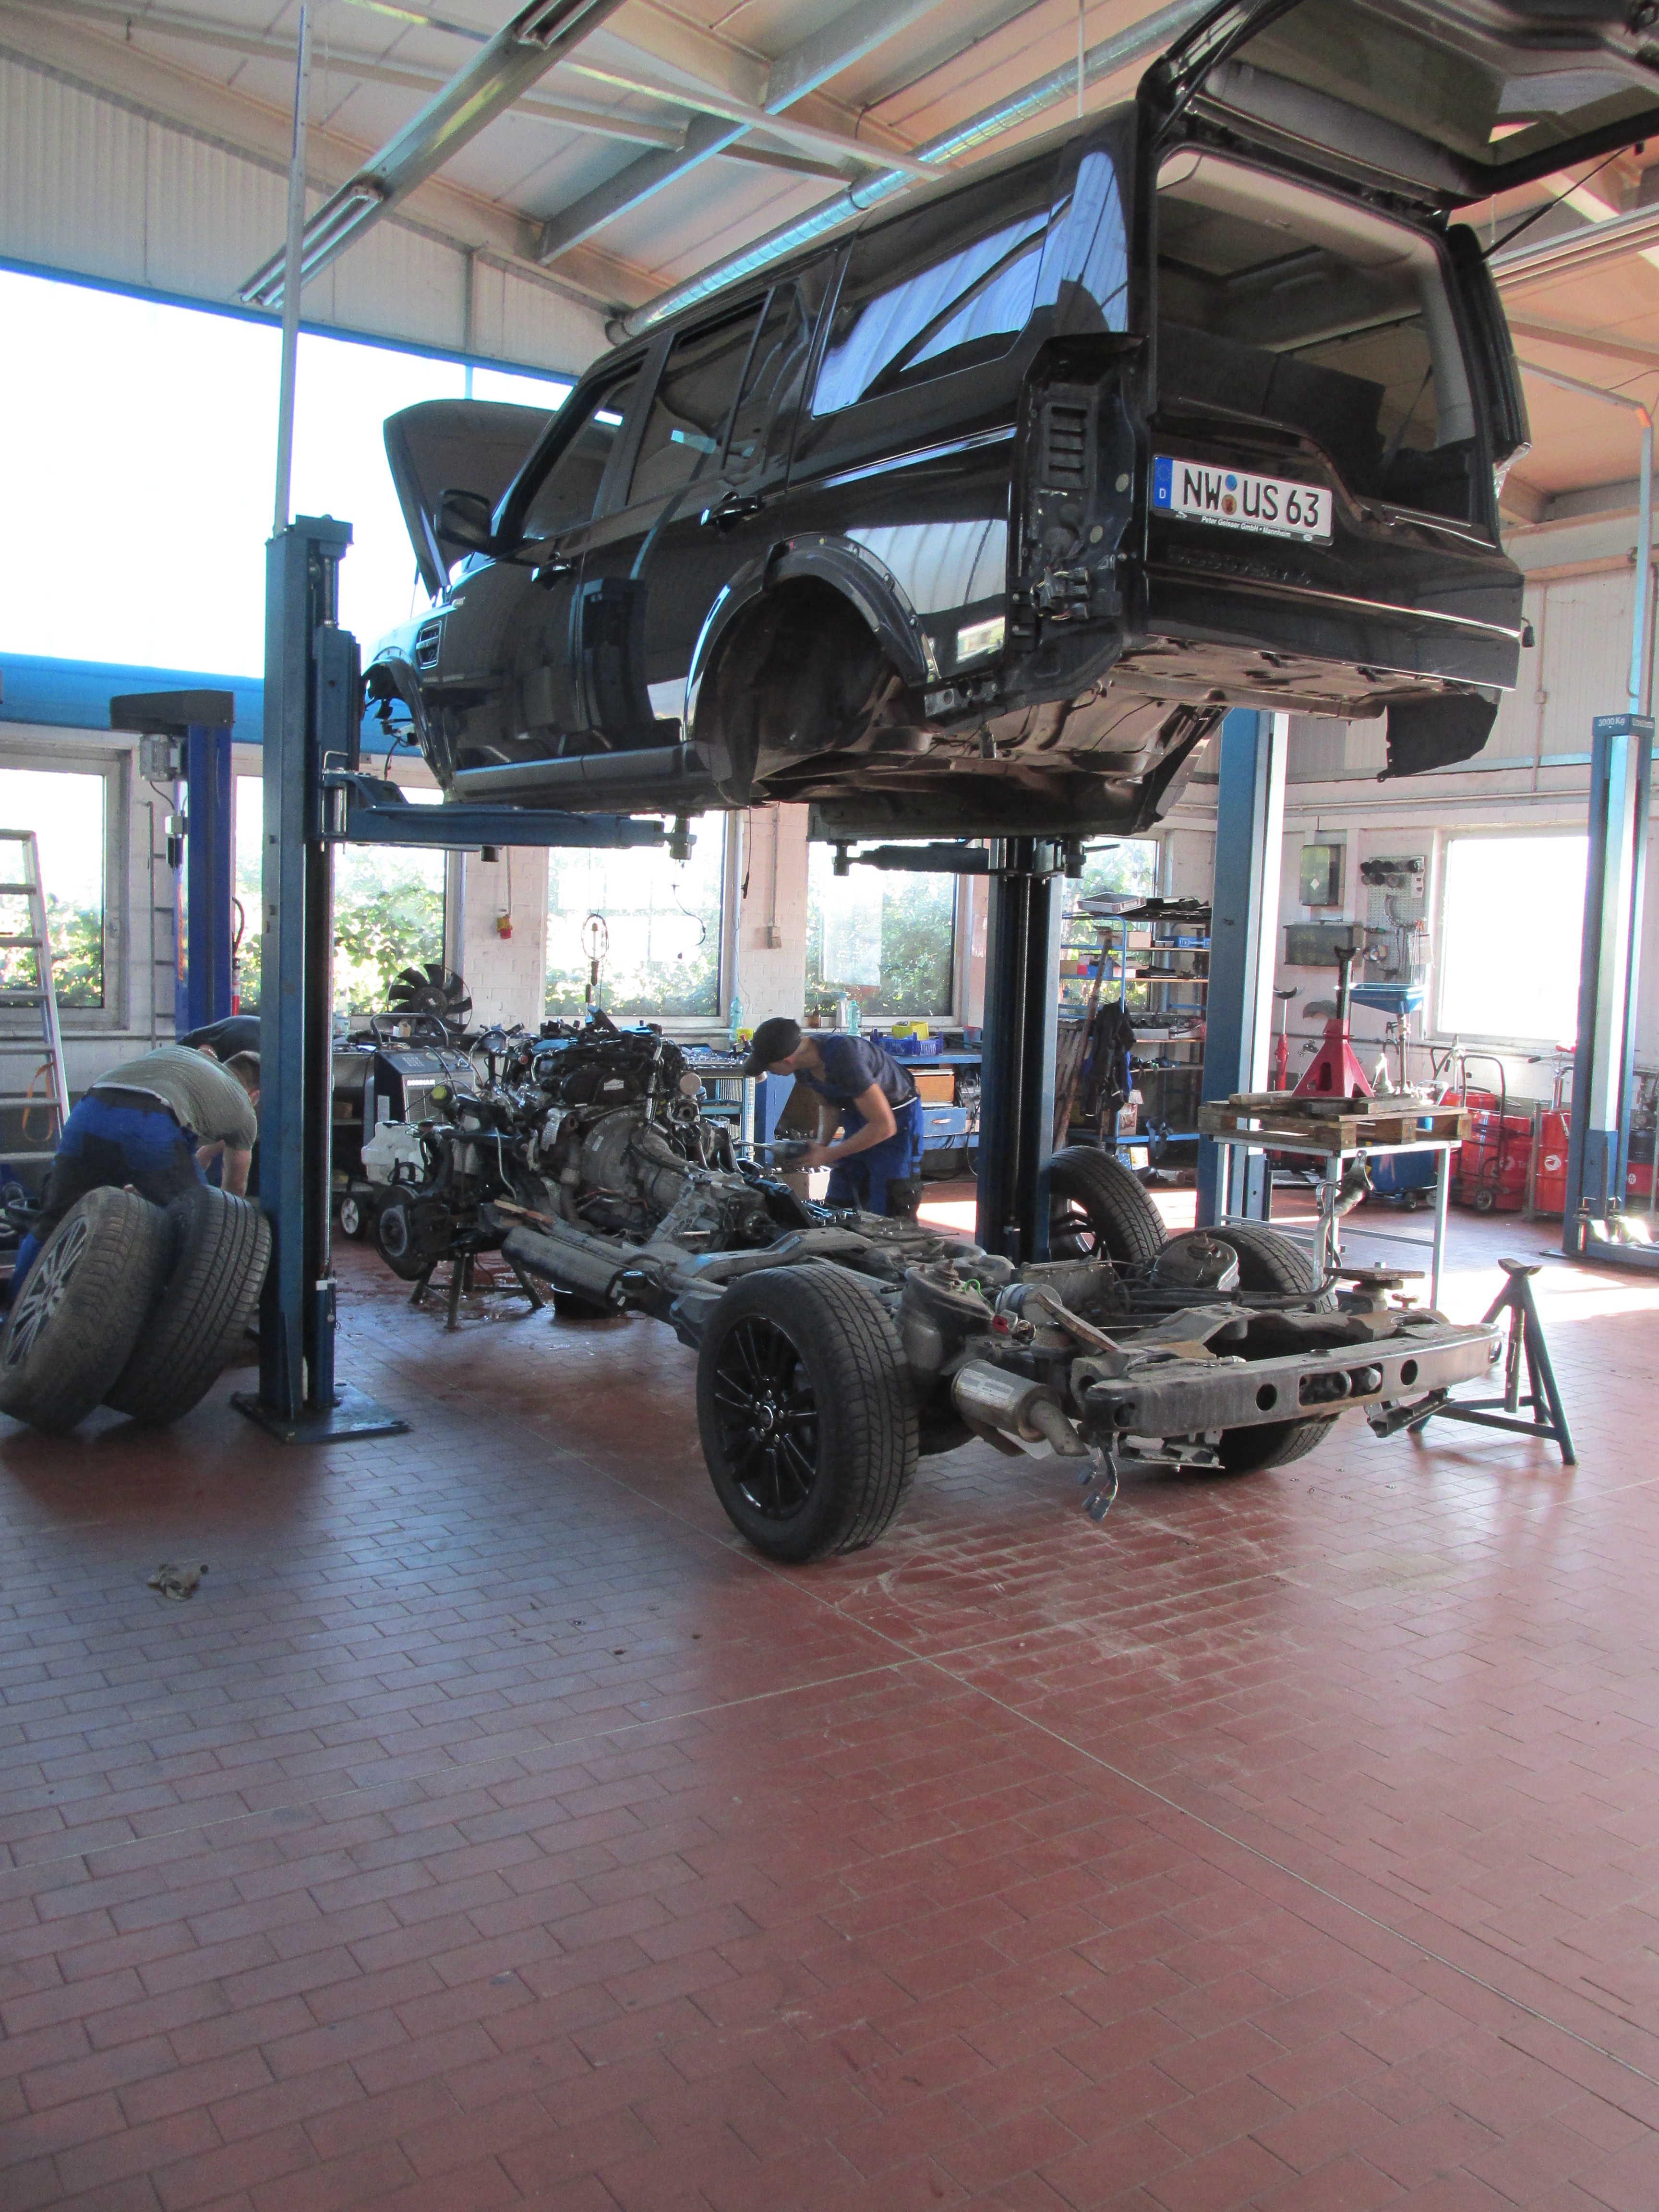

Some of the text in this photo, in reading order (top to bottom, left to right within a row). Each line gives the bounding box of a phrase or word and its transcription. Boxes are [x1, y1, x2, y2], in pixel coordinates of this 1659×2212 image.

[1159, 489, 1166, 499] D
[1183, 469, 1320, 528] NW US 63
[1201, 516, 1217, 524] Peter
[1241, 523, 1259, 532] GmbH
[1262, 527, 1291, 538] Mannheim
[1598, 718, 1614, 726] 3000
